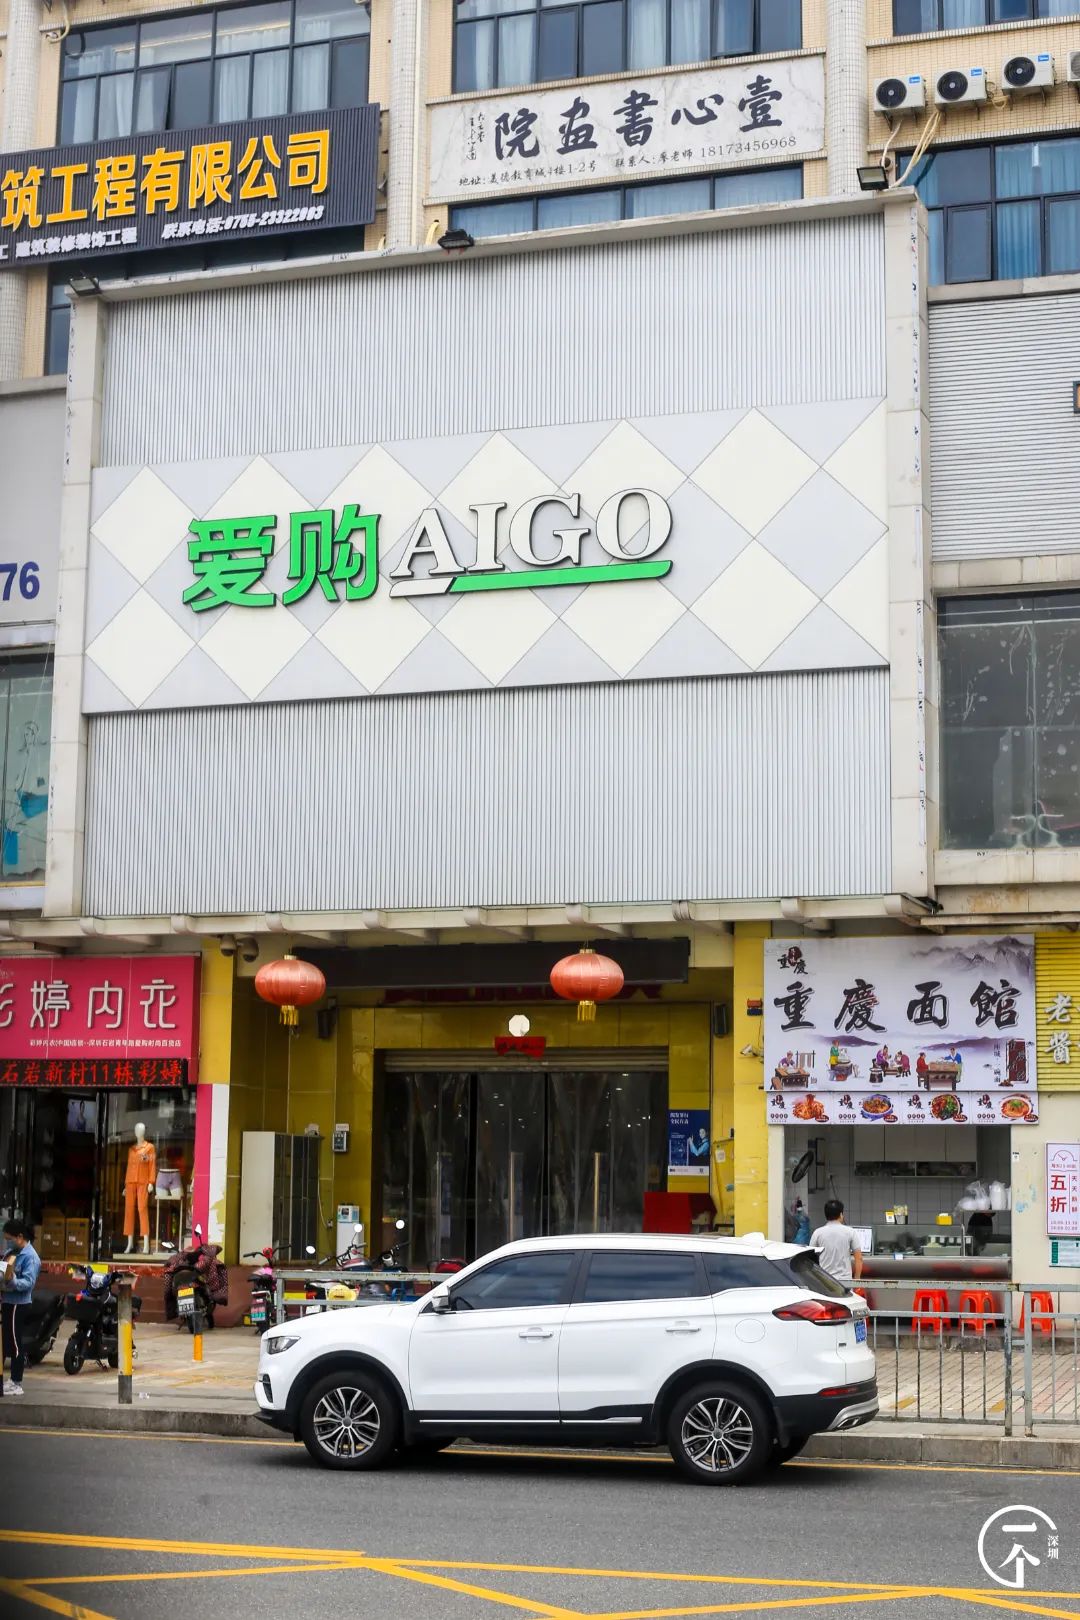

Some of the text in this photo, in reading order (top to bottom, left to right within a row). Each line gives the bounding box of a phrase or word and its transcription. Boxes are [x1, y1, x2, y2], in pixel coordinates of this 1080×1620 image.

[701, 135, 797, 158] 18173456968
[0, 129, 330, 232] 筑工程有限公司
[182, 488, 673, 612] 爱购 AIGO
[0, 561, 40, 601] 76
[1050, 1174, 1067, 1213] 五折
